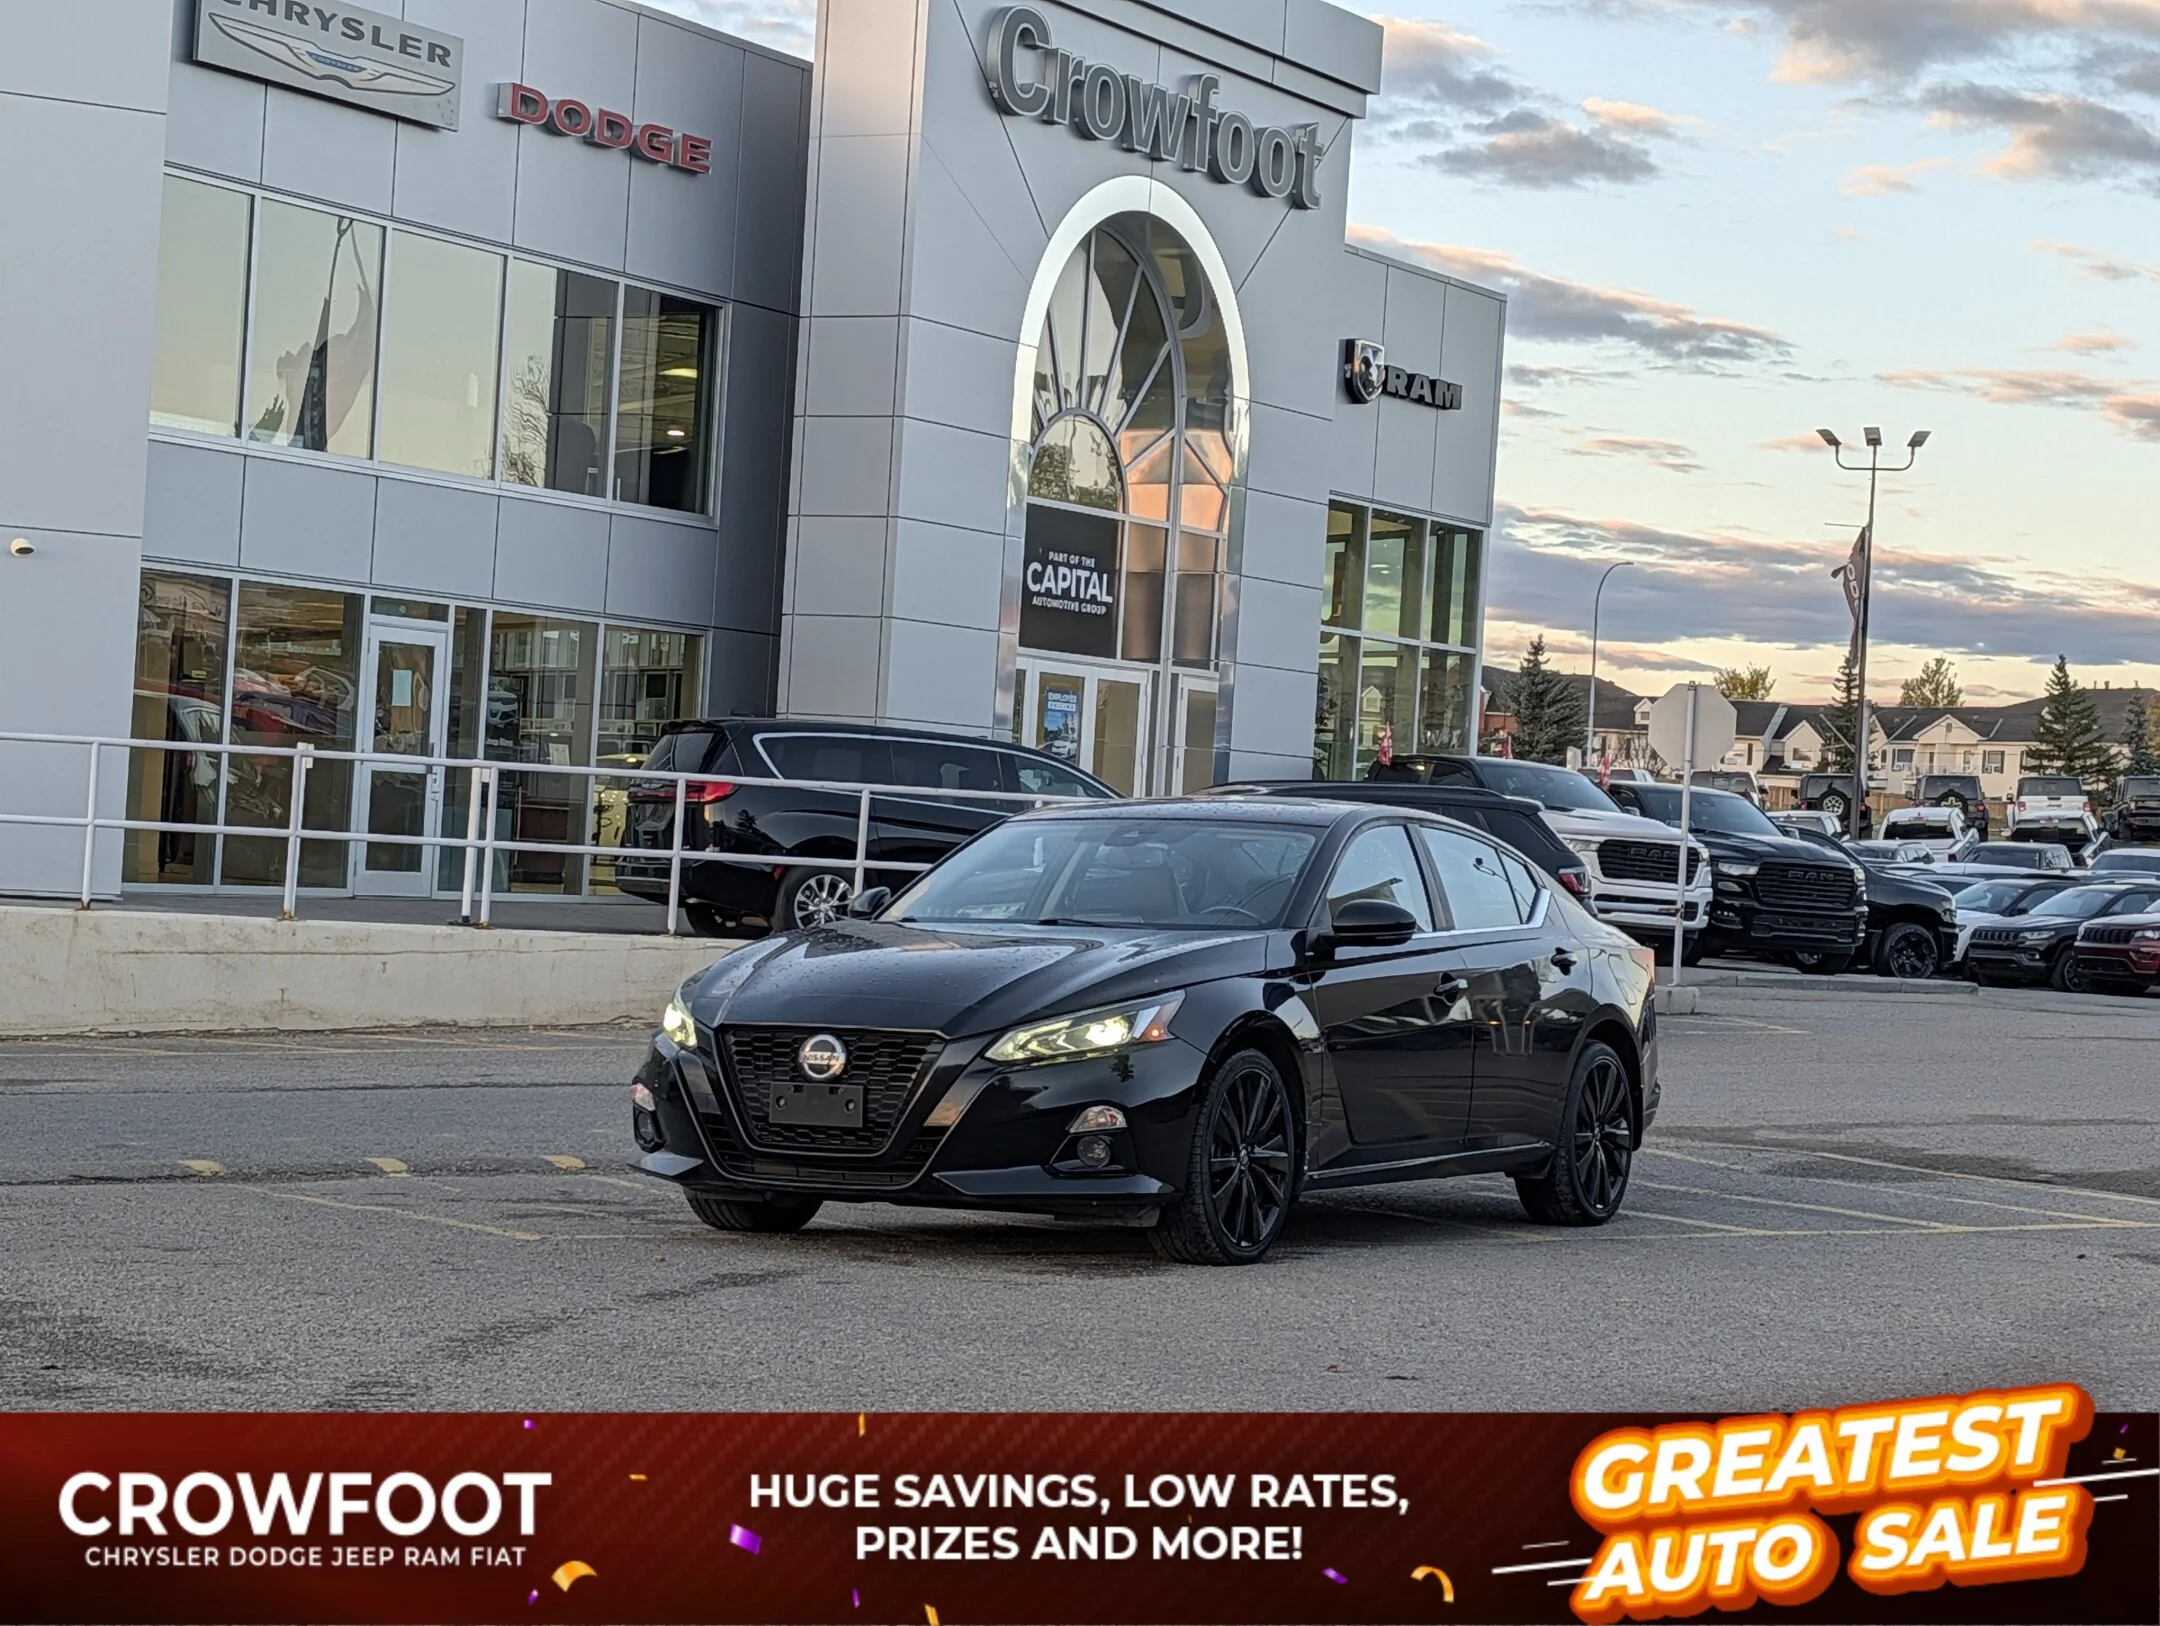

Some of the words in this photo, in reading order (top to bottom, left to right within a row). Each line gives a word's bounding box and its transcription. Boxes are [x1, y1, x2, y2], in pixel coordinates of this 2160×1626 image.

[222, 0, 452, 68] HRYSLER
[990, 4, 1325, 210] Crowfoot
[506, 82, 713, 175] DODGE
[1386, 364, 1462, 410] RAM
[1048, 551, 1067, 563] PART
[1069, 554, 1080, 565] OF
[1081, 556, 1095, 568] THE
[1026, 561, 1113, 603] CAPITAL
[1031, 595, 1080, 612] AUTOMOTIVE
[1080, 602, 1107, 615] GROUP
[1787, 870, 1835, 881] RAM
[803, 1053, 840, 1062] NISSAN
